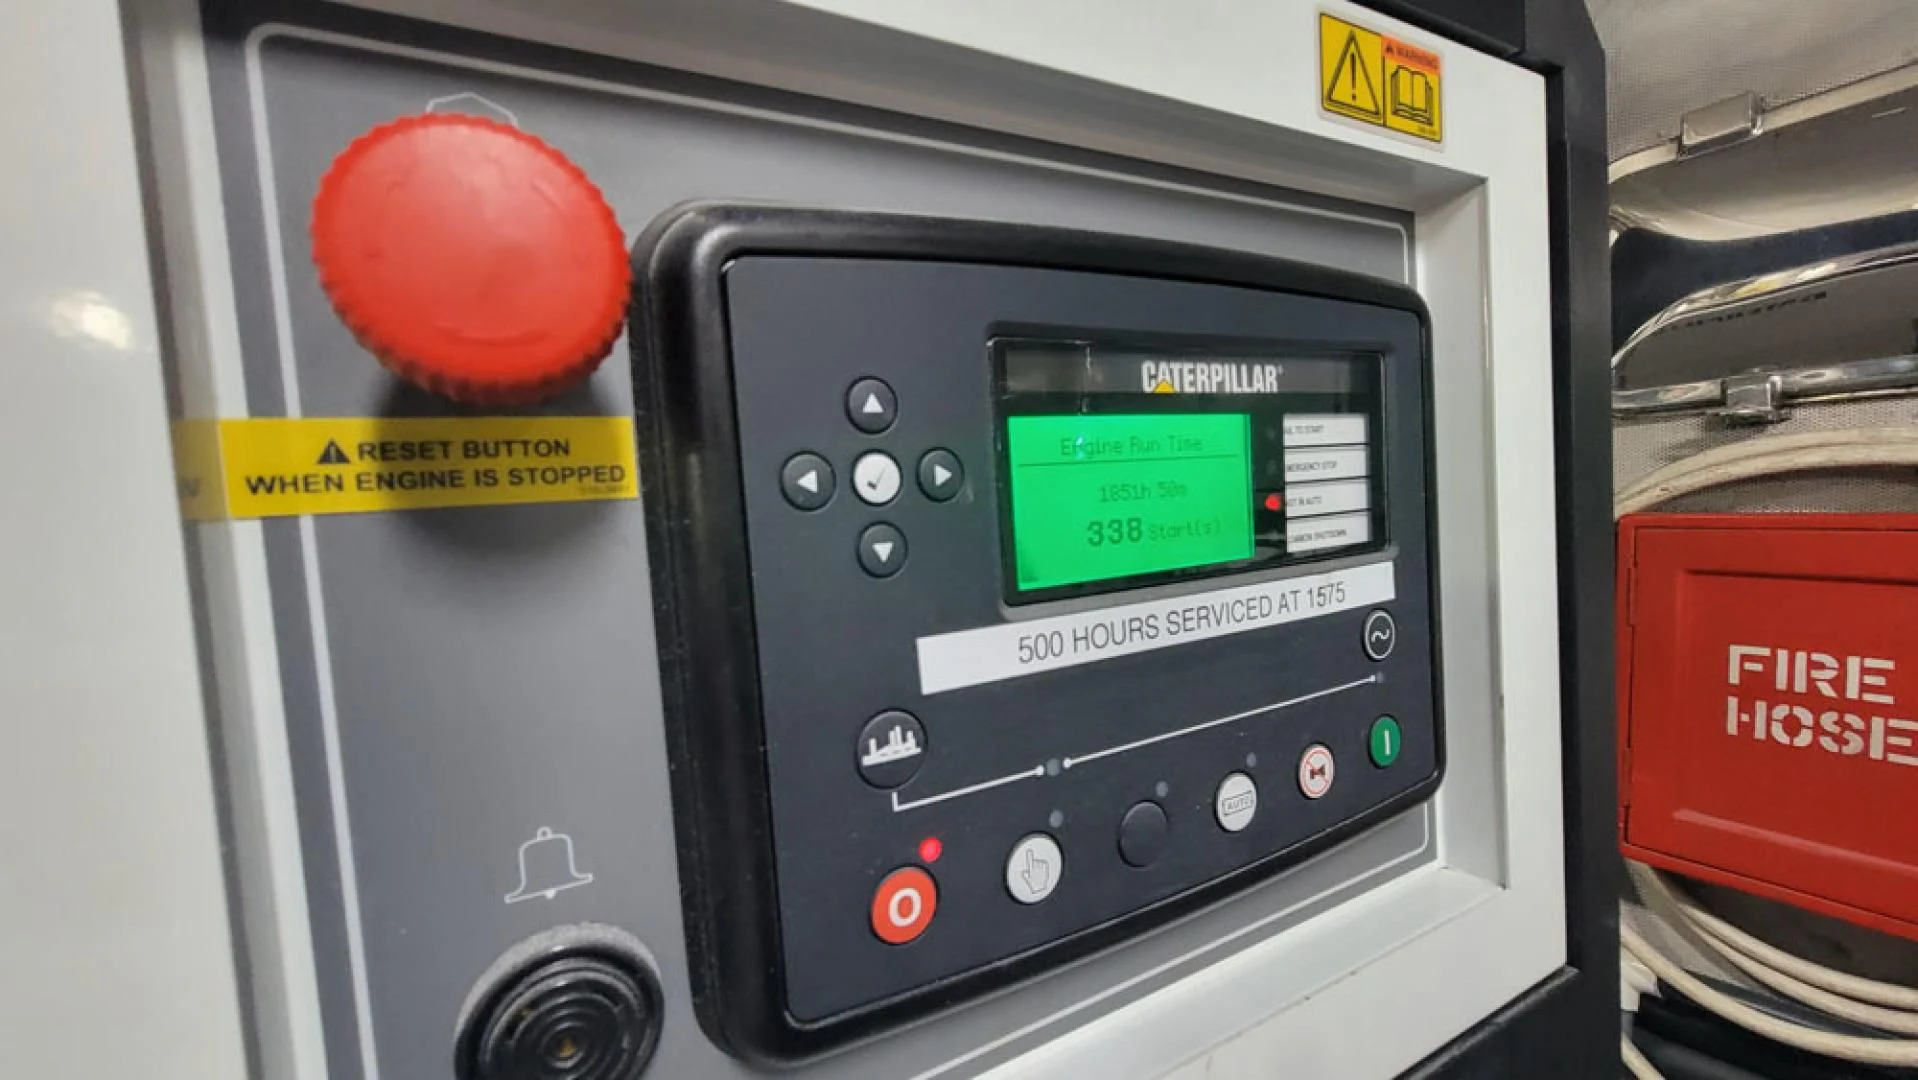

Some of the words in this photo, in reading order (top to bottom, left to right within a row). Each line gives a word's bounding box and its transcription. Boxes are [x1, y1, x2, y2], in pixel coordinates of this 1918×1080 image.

[1141, 360, 1279, 394] CATERPILLAR
[358, 440, 452, 463] RESET
[463, 438, 571, 460] BUTTON
[1130, 436, 1161, 454] Run
[1168, 435, 1204, 452] Time
[245, 473, 344, 495] WHEN
[355, 469, 465, 493] ENGINE
[474, 467, 498, 487] IS
[508, 463, 626, 486] STOPPED
[1098, 482, 1151, 504] 1851h
[1087, 517, 1145, 547] 338
[1017, 634, 1064, 665] 500
[1072, 612, 1160, 655] HOURS
[1166, 593, 1273, 637] SERVICED
[1278, 589, 1301, 616] AT
[1307, 582, 1346, 610] 1575
[1727, 643, 1896, 705] FIRE
[1726, 695, 1918, 767] HOSE
